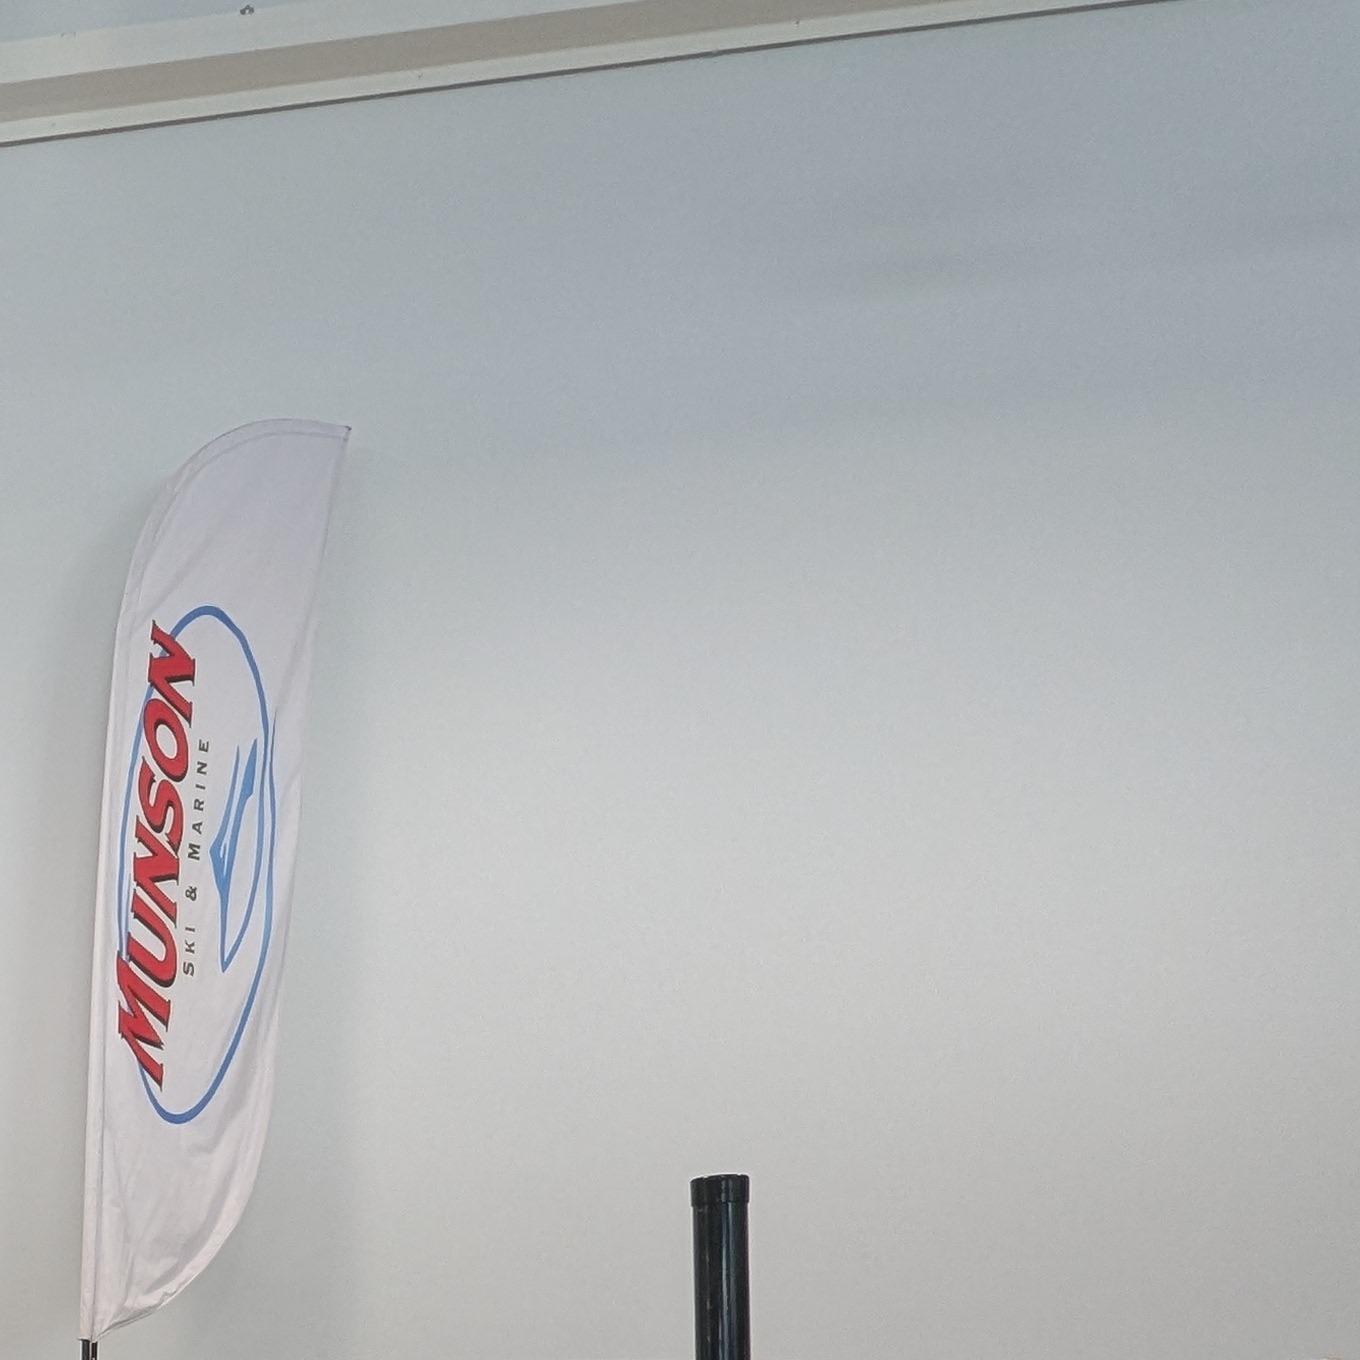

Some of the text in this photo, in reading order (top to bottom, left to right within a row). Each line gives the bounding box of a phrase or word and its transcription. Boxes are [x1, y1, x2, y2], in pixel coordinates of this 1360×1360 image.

[117, 619, 196, 1093] MUNSON
[183, 739, 210, 977] SKI & MARINE
